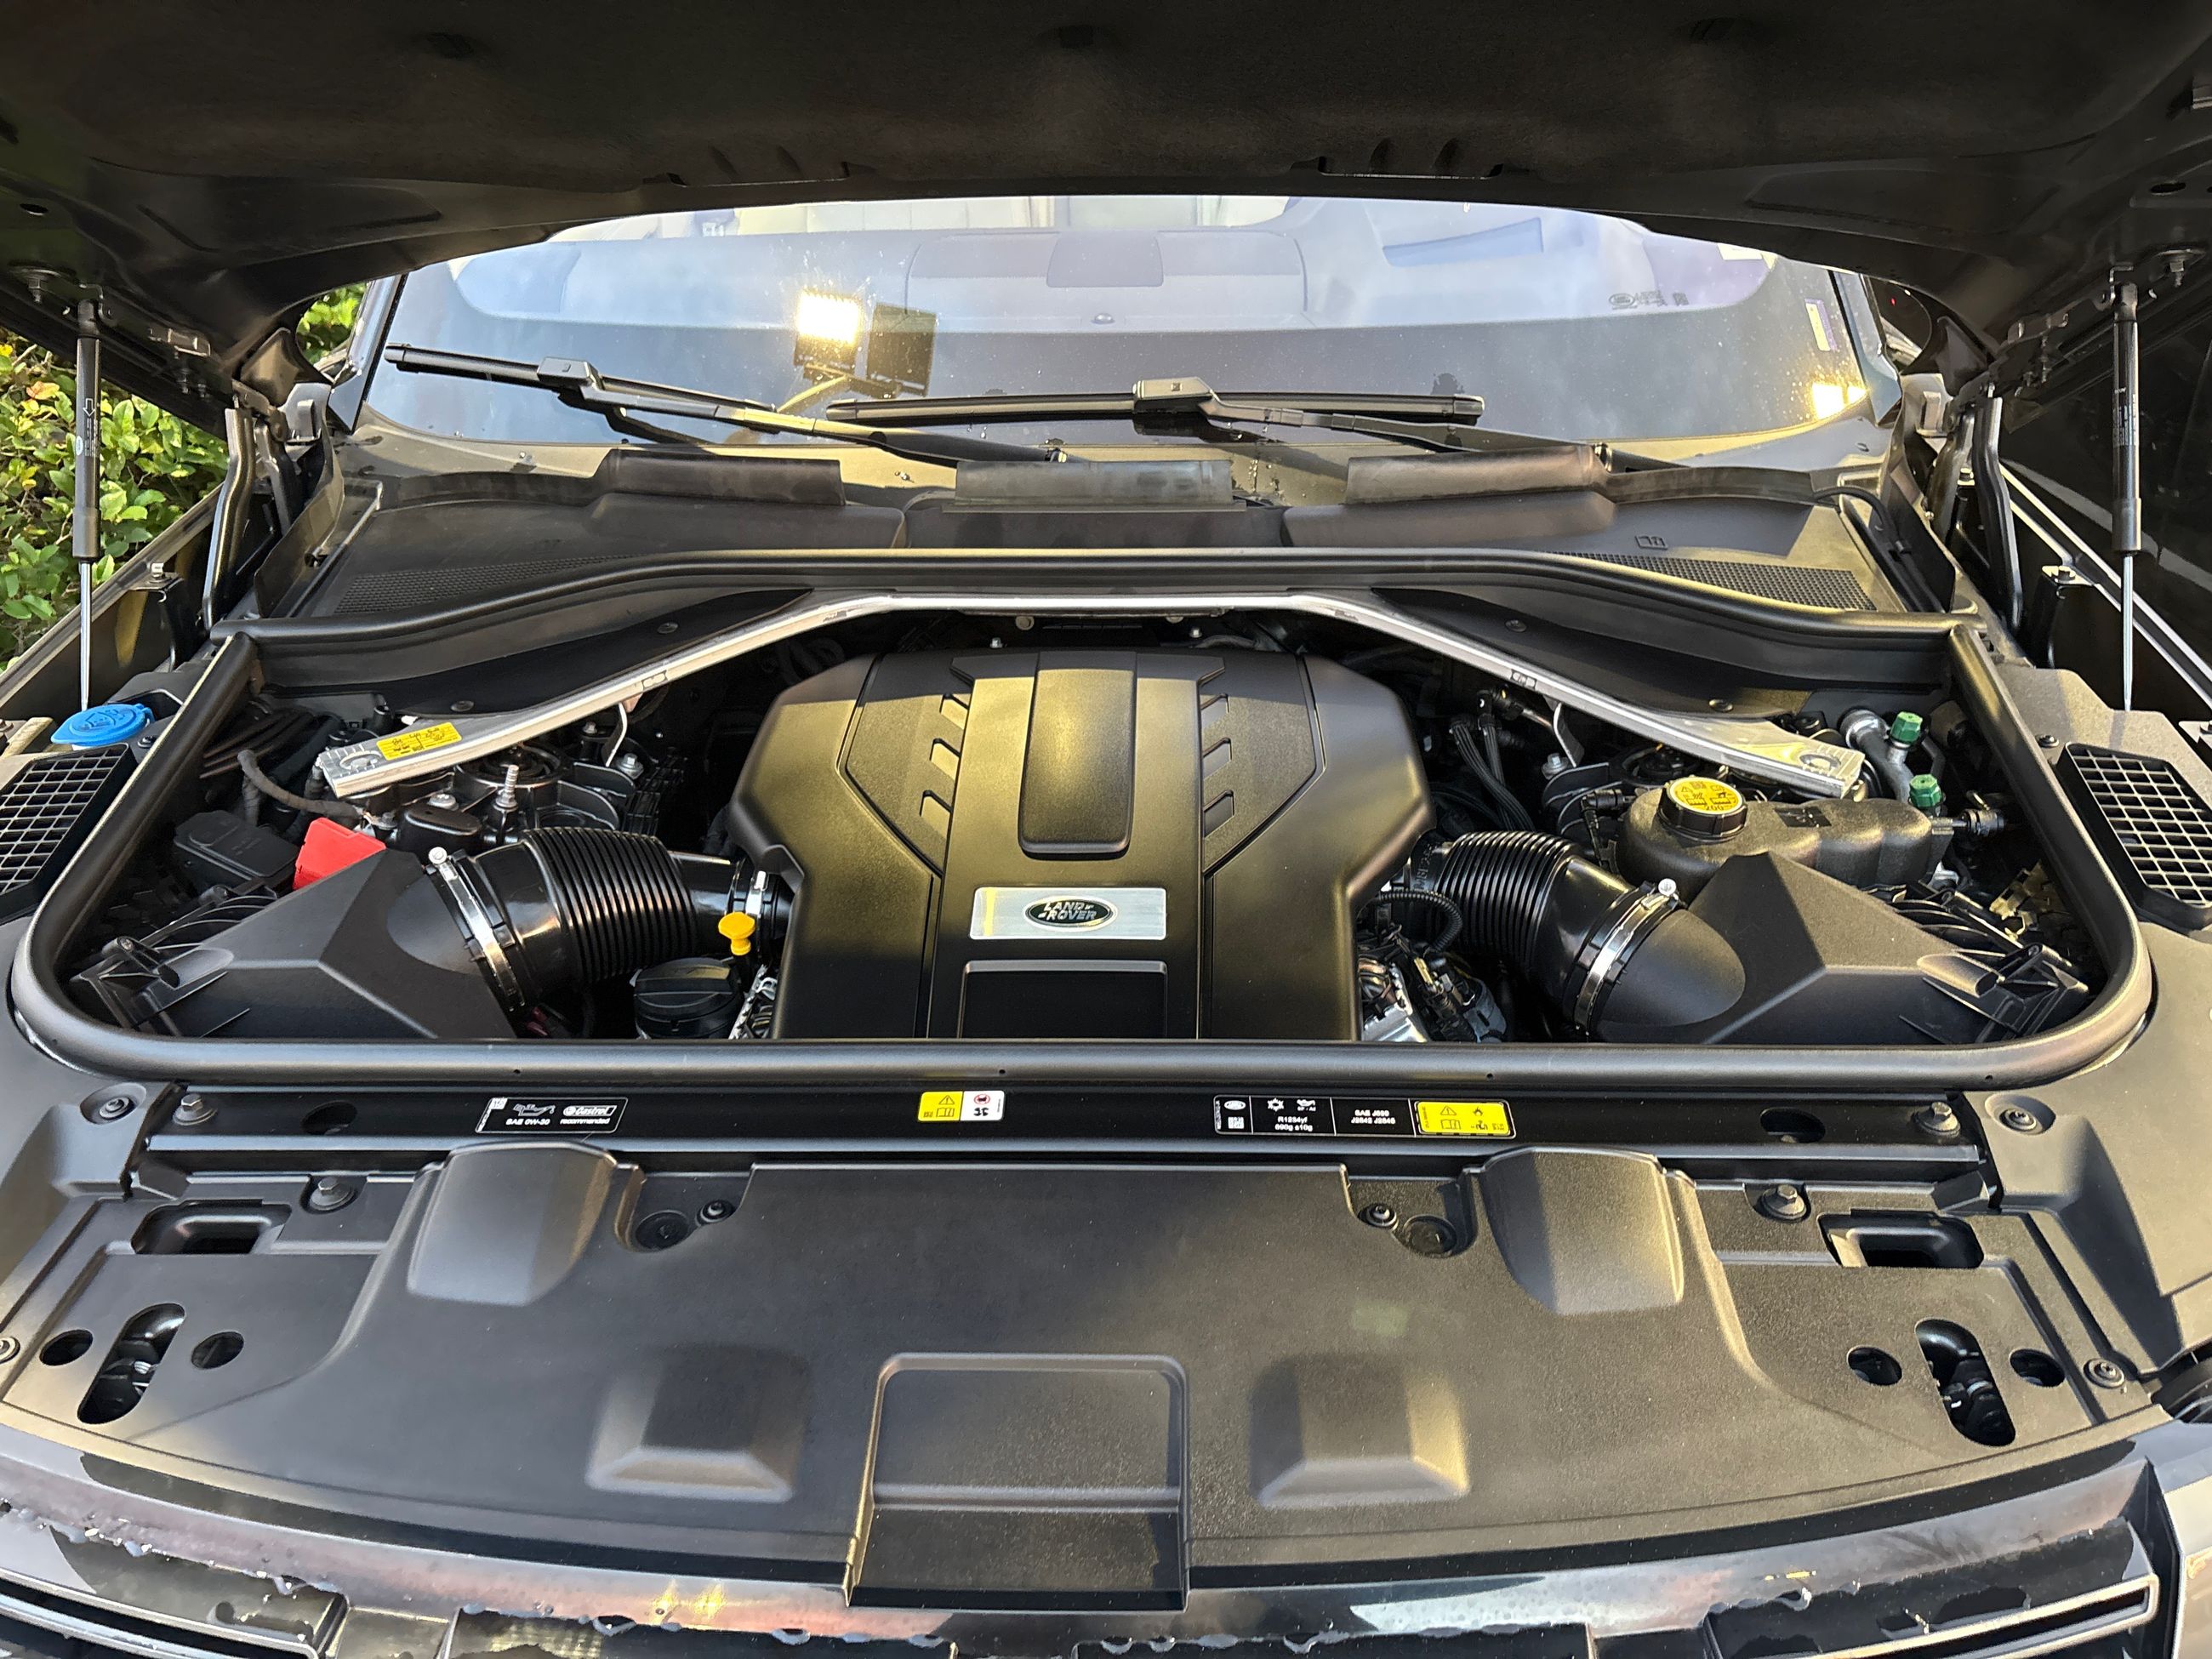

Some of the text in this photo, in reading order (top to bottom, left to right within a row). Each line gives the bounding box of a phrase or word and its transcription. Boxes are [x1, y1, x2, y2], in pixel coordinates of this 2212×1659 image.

[1043, 901, 1085, 911] LAND
[1046, 910, 1097, 921] ROVER
[575, 1106, 609, 1115] Castrol
